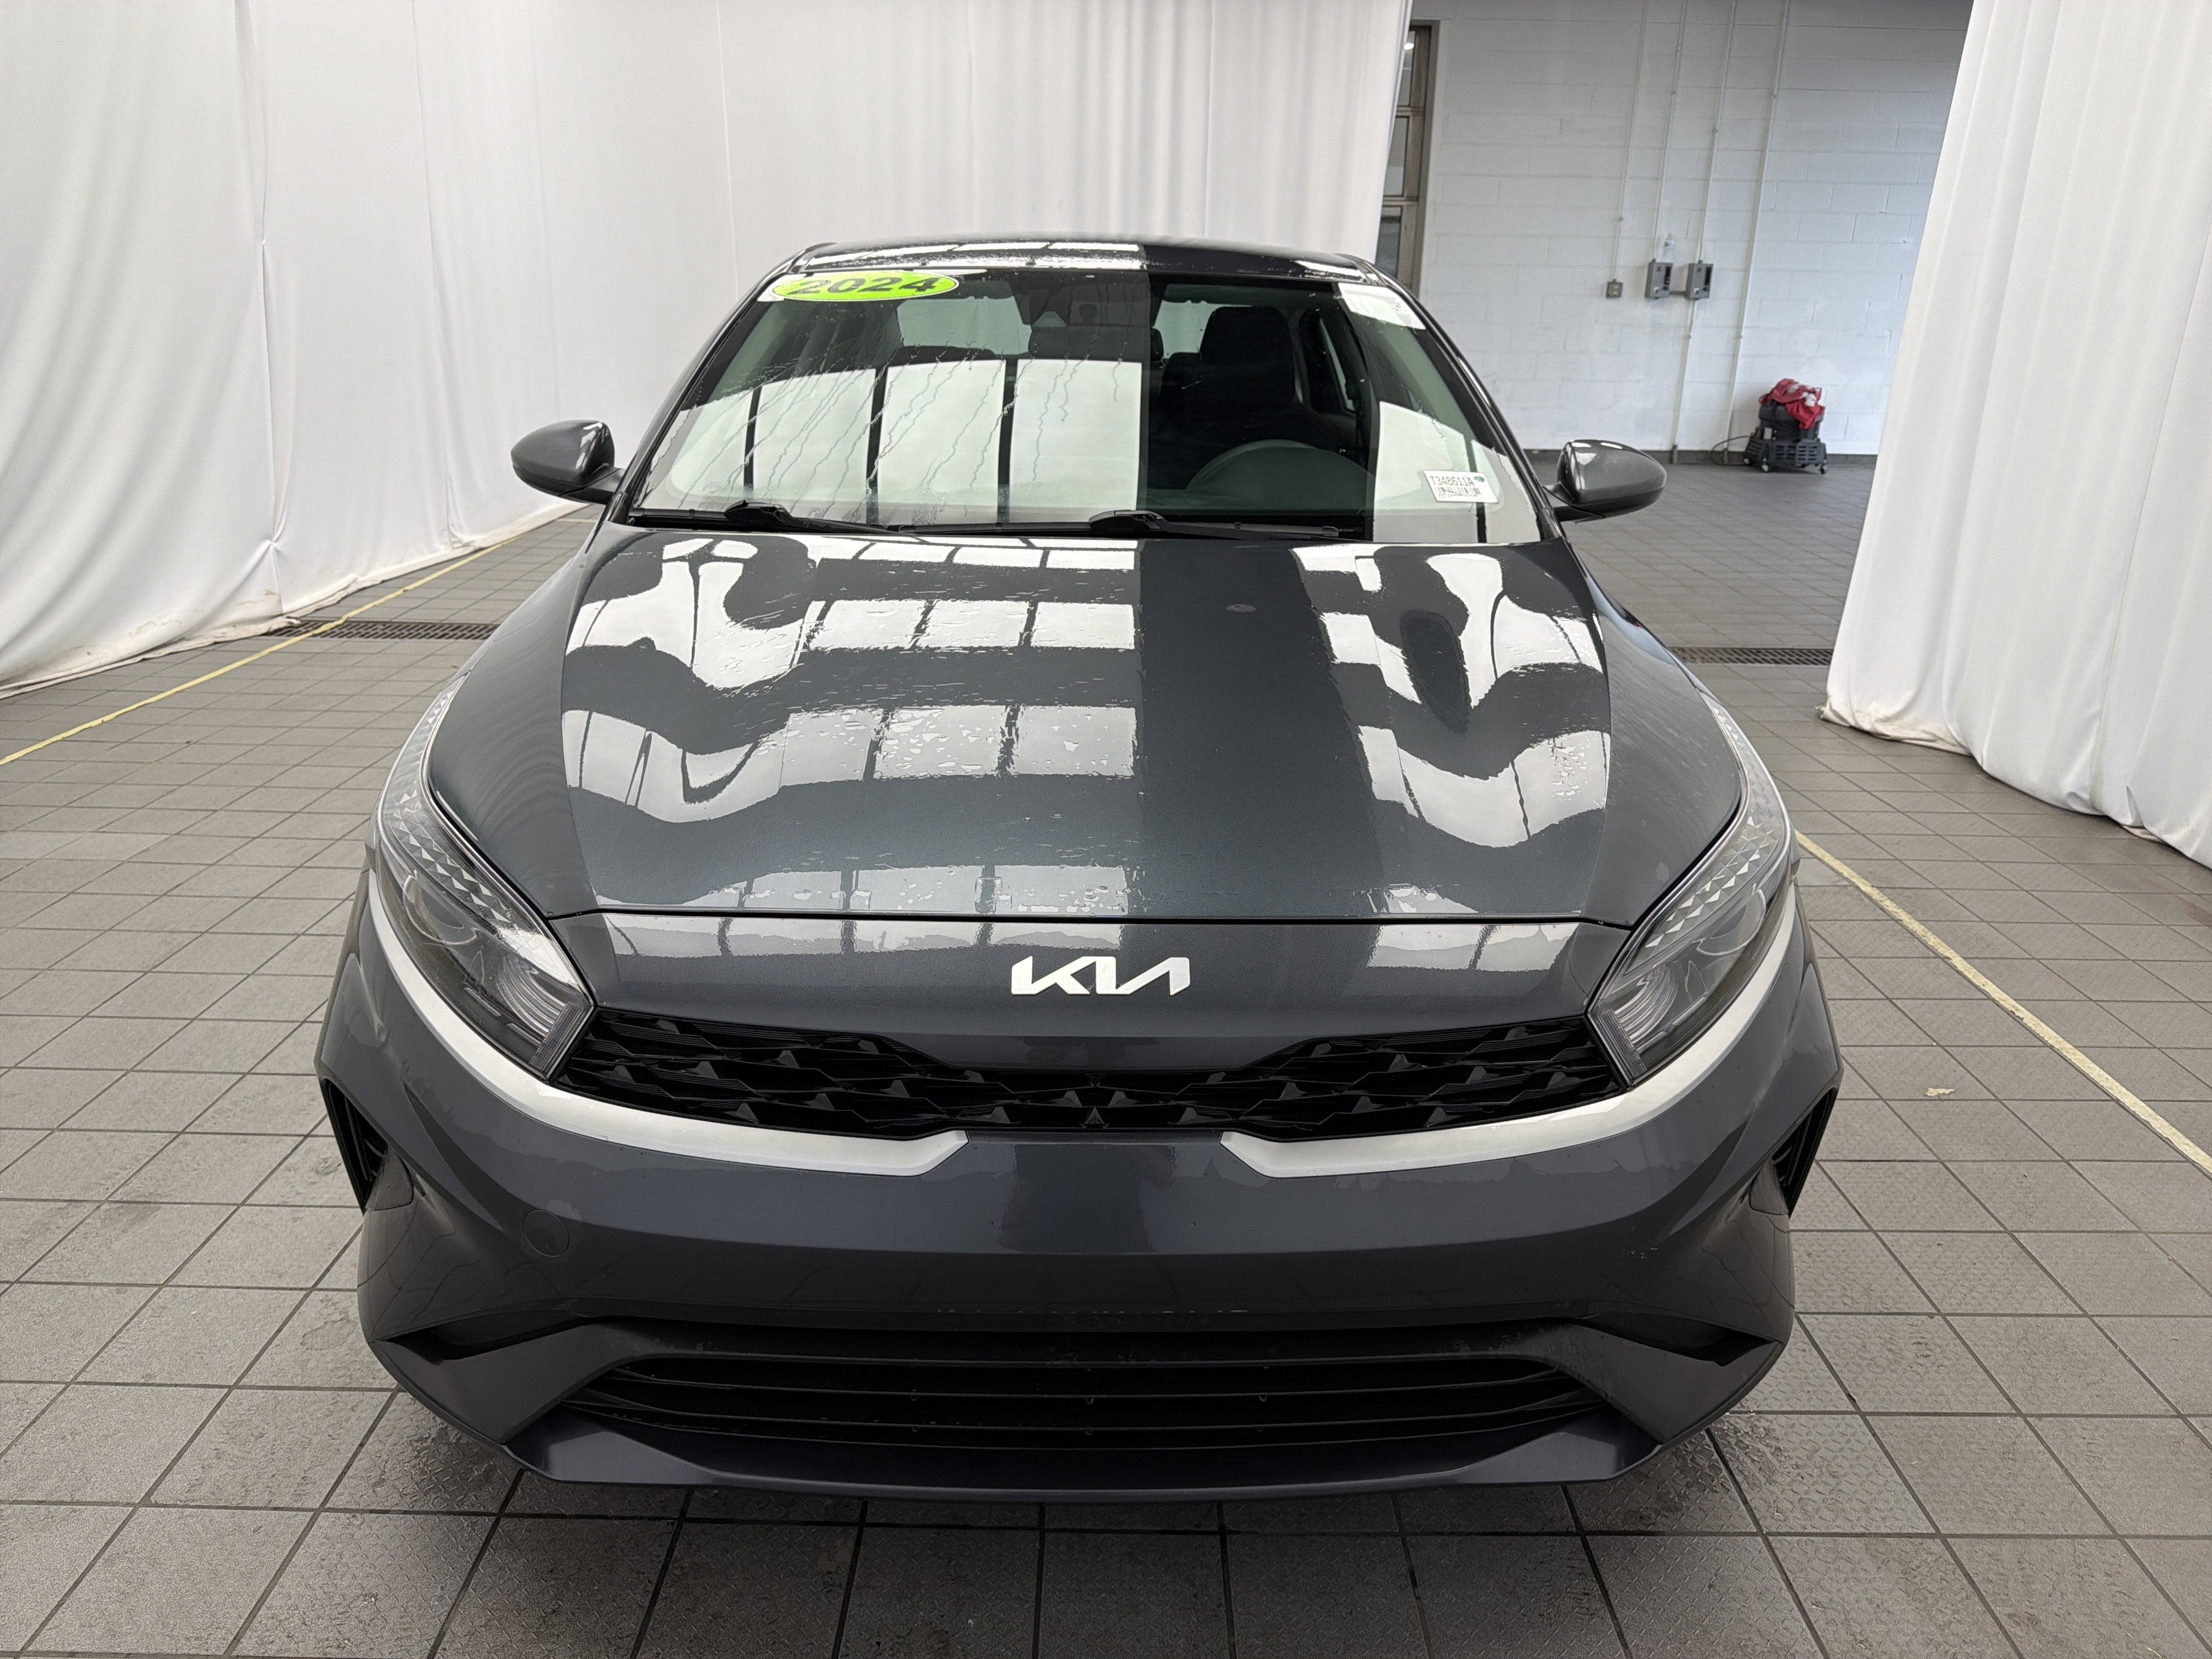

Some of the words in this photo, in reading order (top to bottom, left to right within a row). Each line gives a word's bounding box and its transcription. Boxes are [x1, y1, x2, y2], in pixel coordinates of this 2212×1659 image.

[786, 276, 942, 295] 2024
[1429, 476, 1475, 487] T348611A
[1011, 956, 1190, 996] KIA
